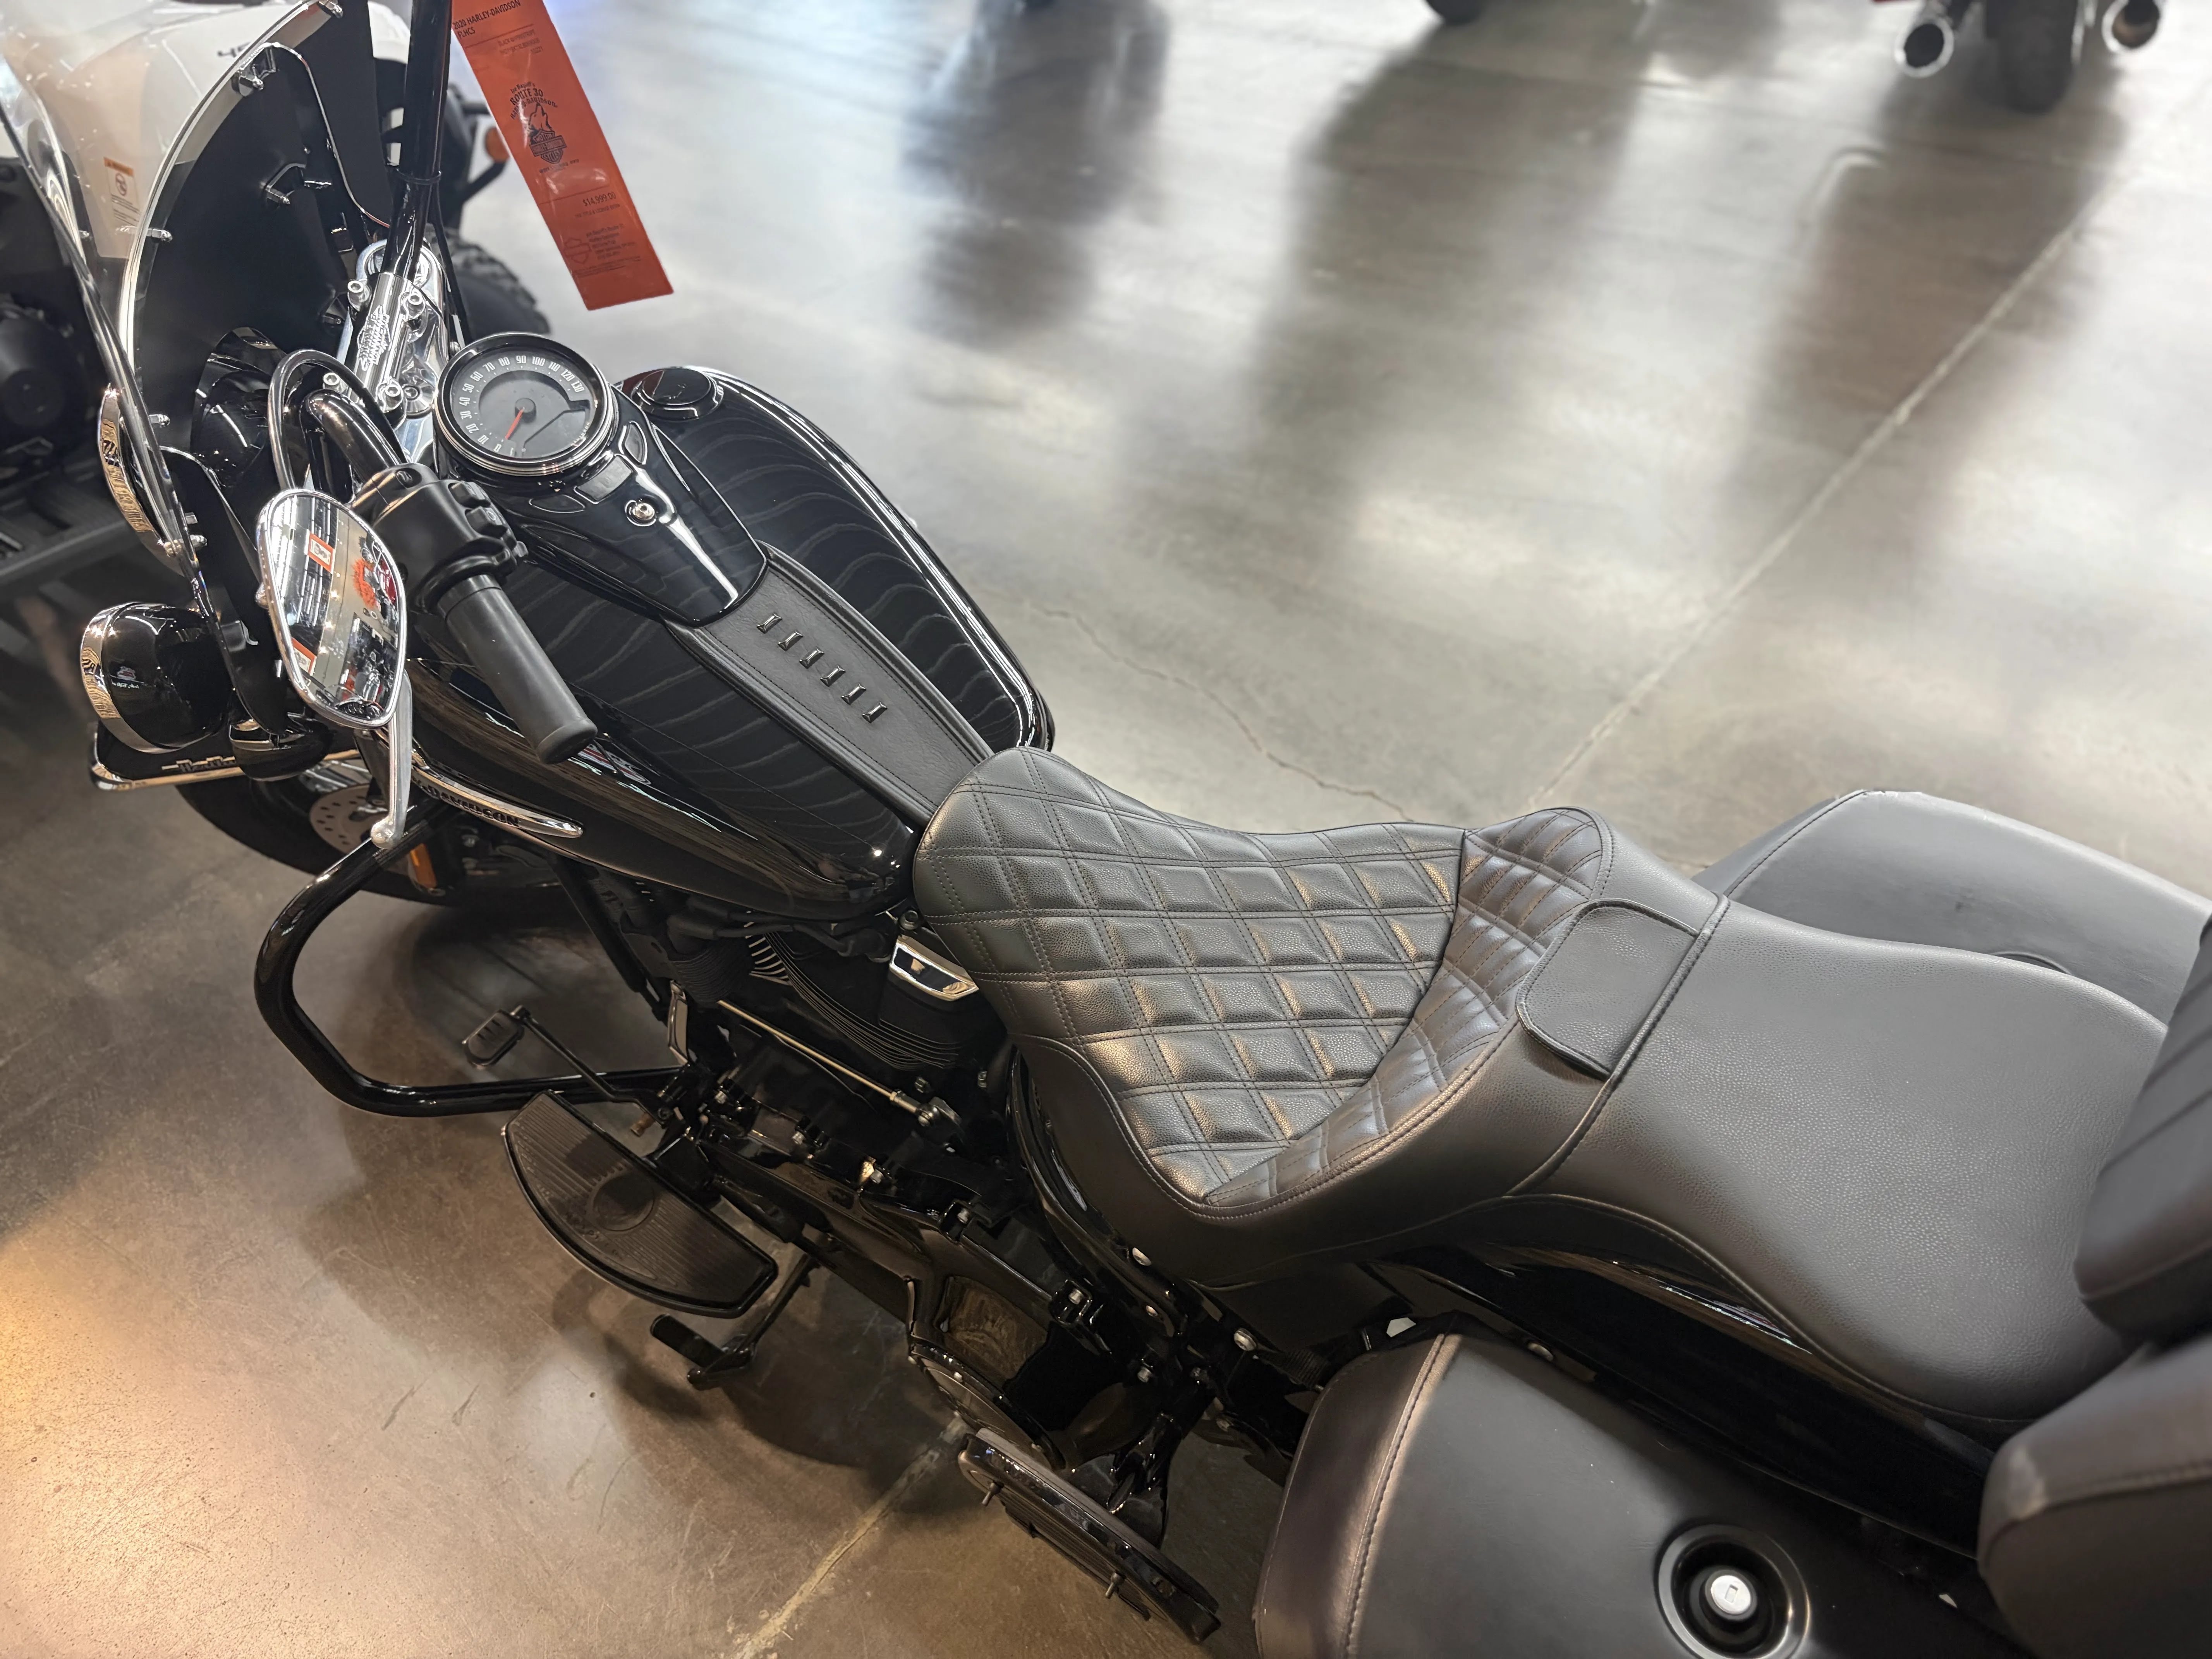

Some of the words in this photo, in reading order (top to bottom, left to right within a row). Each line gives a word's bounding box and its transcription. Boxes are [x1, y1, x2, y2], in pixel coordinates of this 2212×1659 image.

[453, 19, 467, 29] 2020
[467, 0, 521, 25] HARLEY-DAVIDSON
[510, 88, 532, 106] ROUTE
[533, 88, 543, 97] 30
[498, 357, 510, 366] 80
[516, 355, 526, 364] 90
[532, 356, 546, 366] 100
[483, 362, 496, 372] 70
[548, 361, 561, 372] 110
[470, 371, 484, 382] 60
[561, 369, 575, 382] 120
[462, 383, 475, 393] 50
[571, 380, 585, 393] 130
[459, 397, 471, 406] 40
[460, 410, 472, 420] 30
[466, 423, 479, 434] 20
[477, 434, 489, 445] 10
[493, 443, 502, 453] 0
